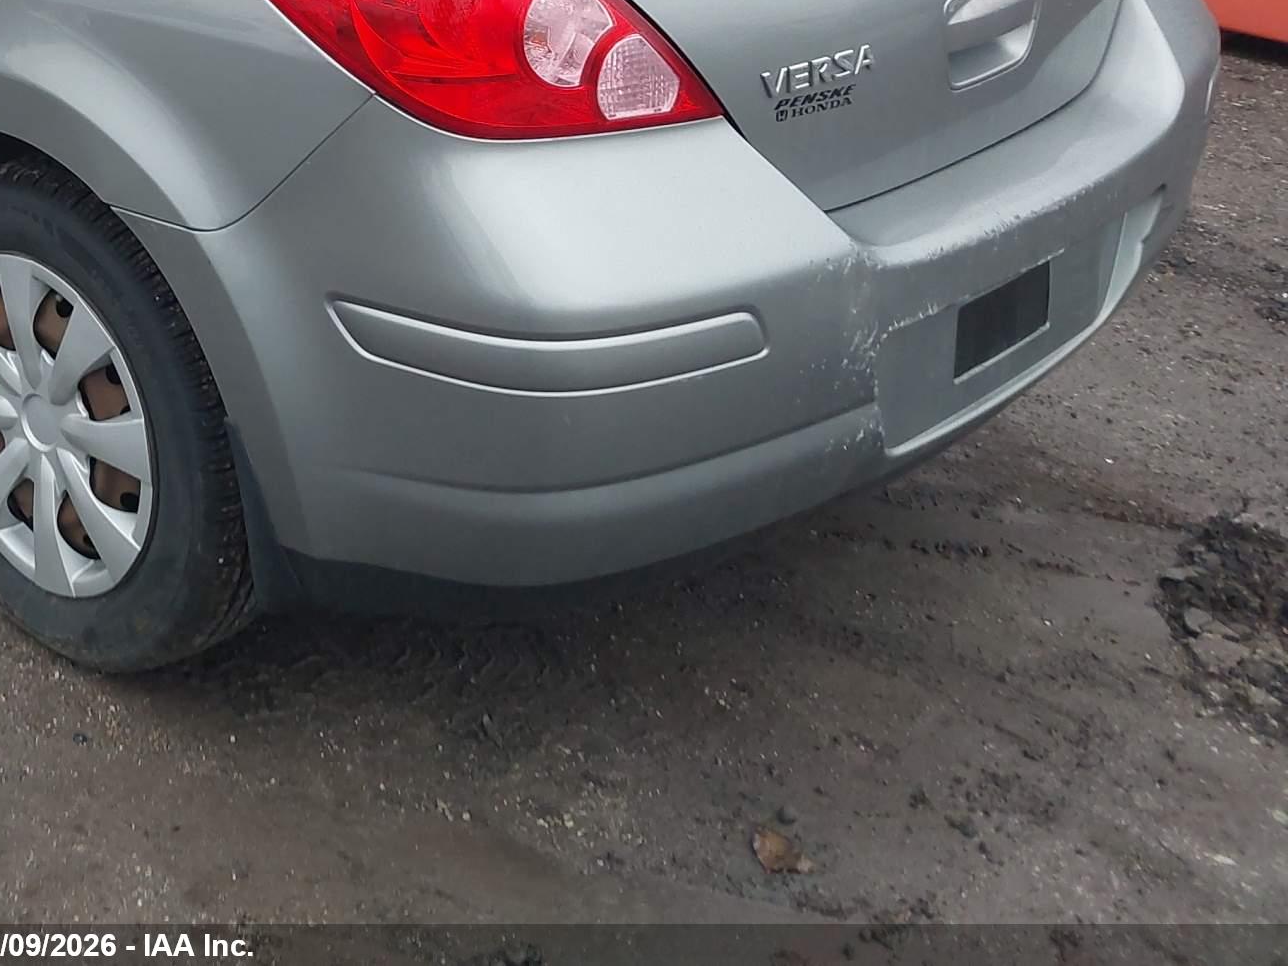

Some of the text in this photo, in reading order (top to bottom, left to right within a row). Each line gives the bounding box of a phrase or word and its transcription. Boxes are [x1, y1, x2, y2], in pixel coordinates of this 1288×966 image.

[760, 44, 873, 99] VERSA
[774, 84, 856, 110] PENSKE
[792, 97, 852, 118] HONDA
